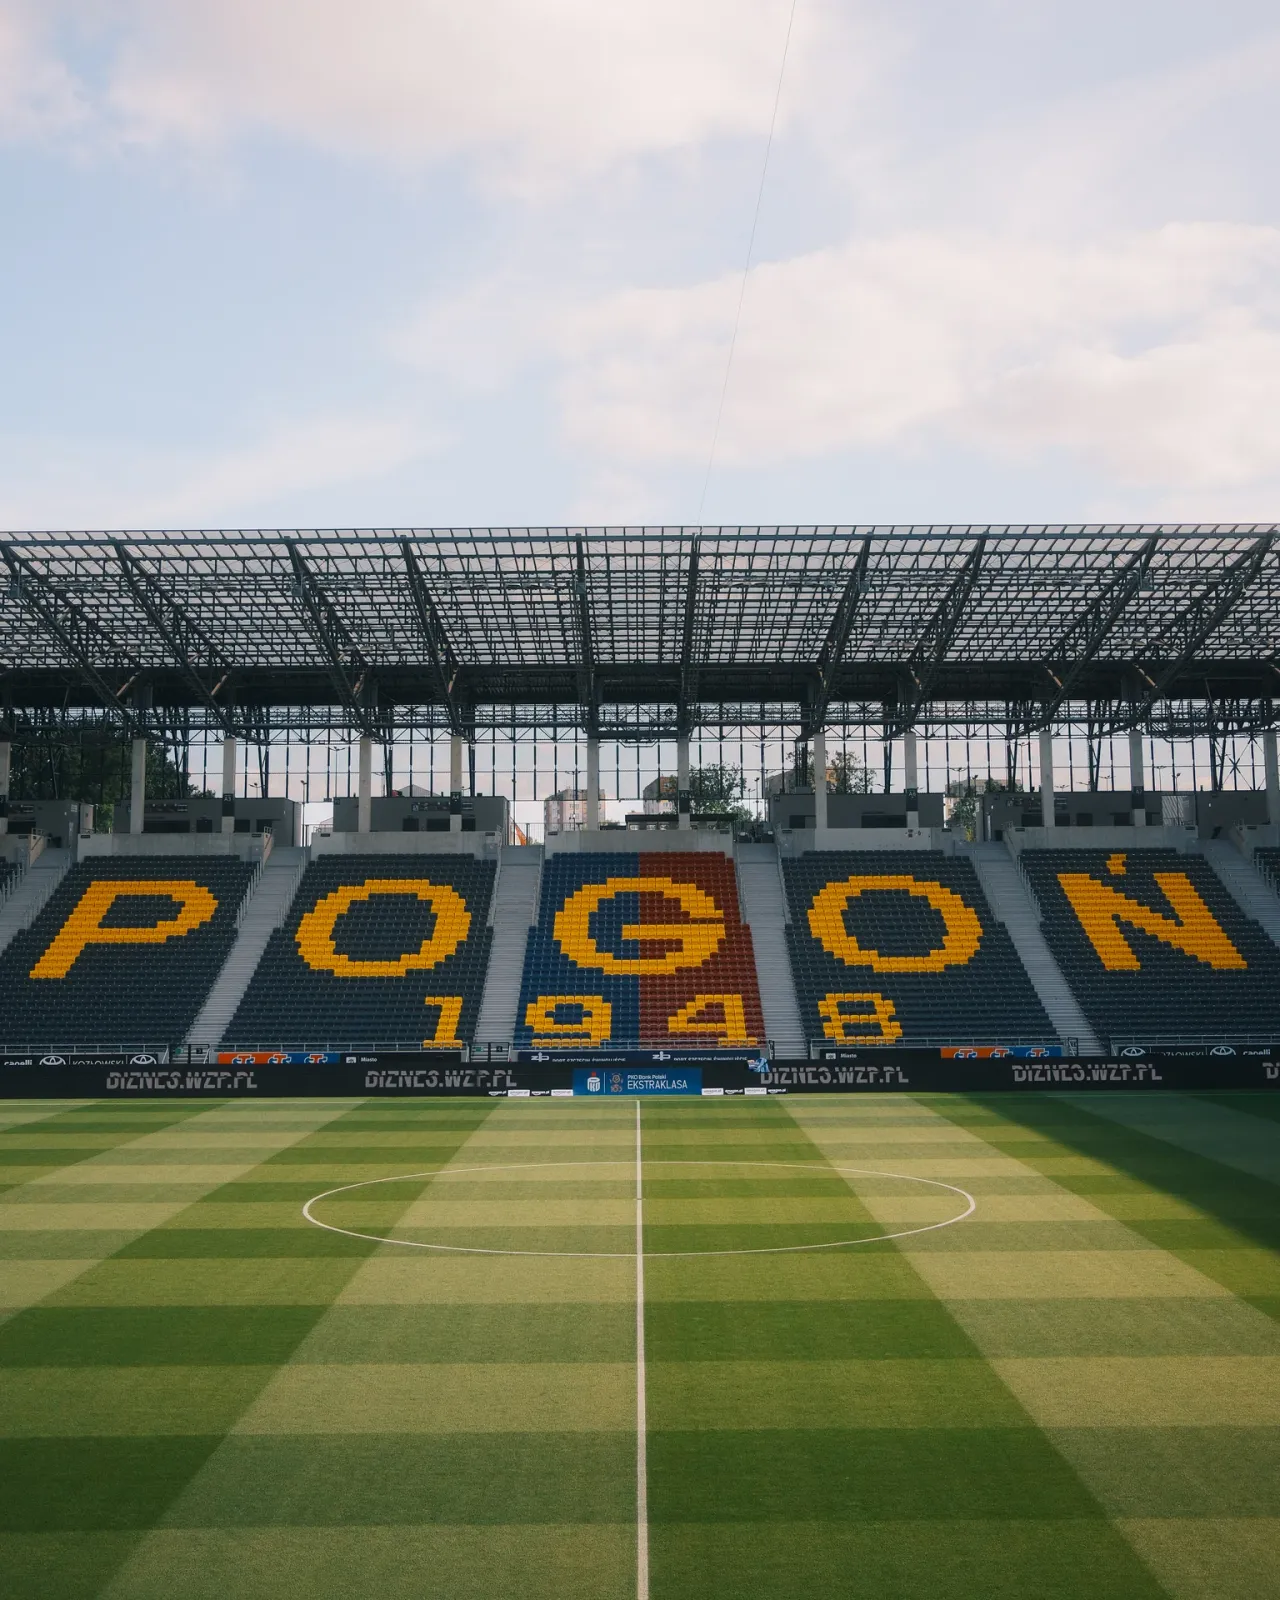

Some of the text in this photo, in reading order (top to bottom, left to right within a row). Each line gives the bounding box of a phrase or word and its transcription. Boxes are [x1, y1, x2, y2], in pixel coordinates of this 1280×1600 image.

[29, 853, 1248, 979] POGOŃ
[423, 992, 903, 1049] 1948
[627, 1080, 688, 1089] EKSTRAKLASA
